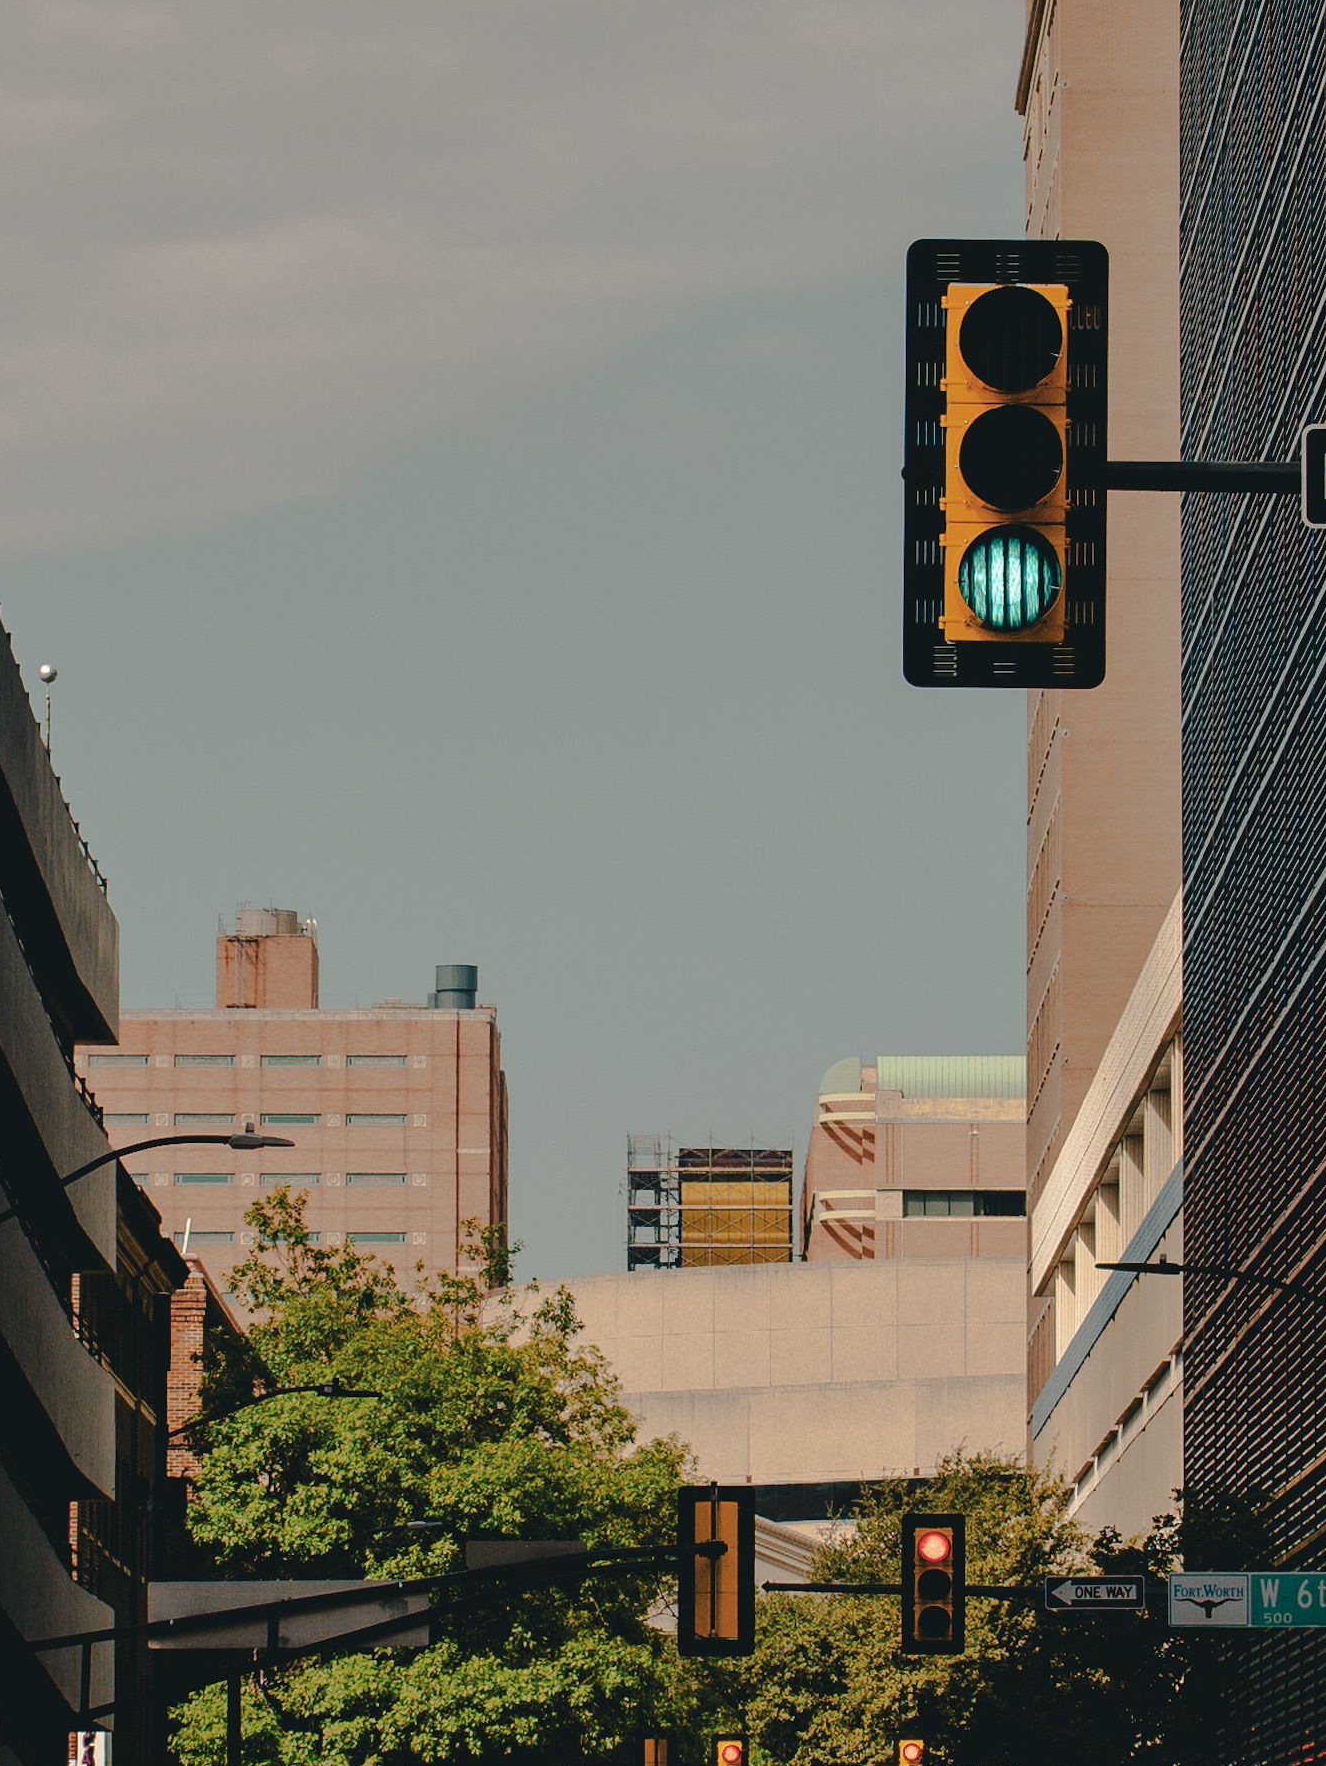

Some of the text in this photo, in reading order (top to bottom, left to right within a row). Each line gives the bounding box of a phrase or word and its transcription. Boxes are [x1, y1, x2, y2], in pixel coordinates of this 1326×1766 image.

[1075, 1585, 1133, 1599] ONE WAY
[1259, 1578, 1280, 1609] W
[1263, 1612, 1293, 1625] 500
